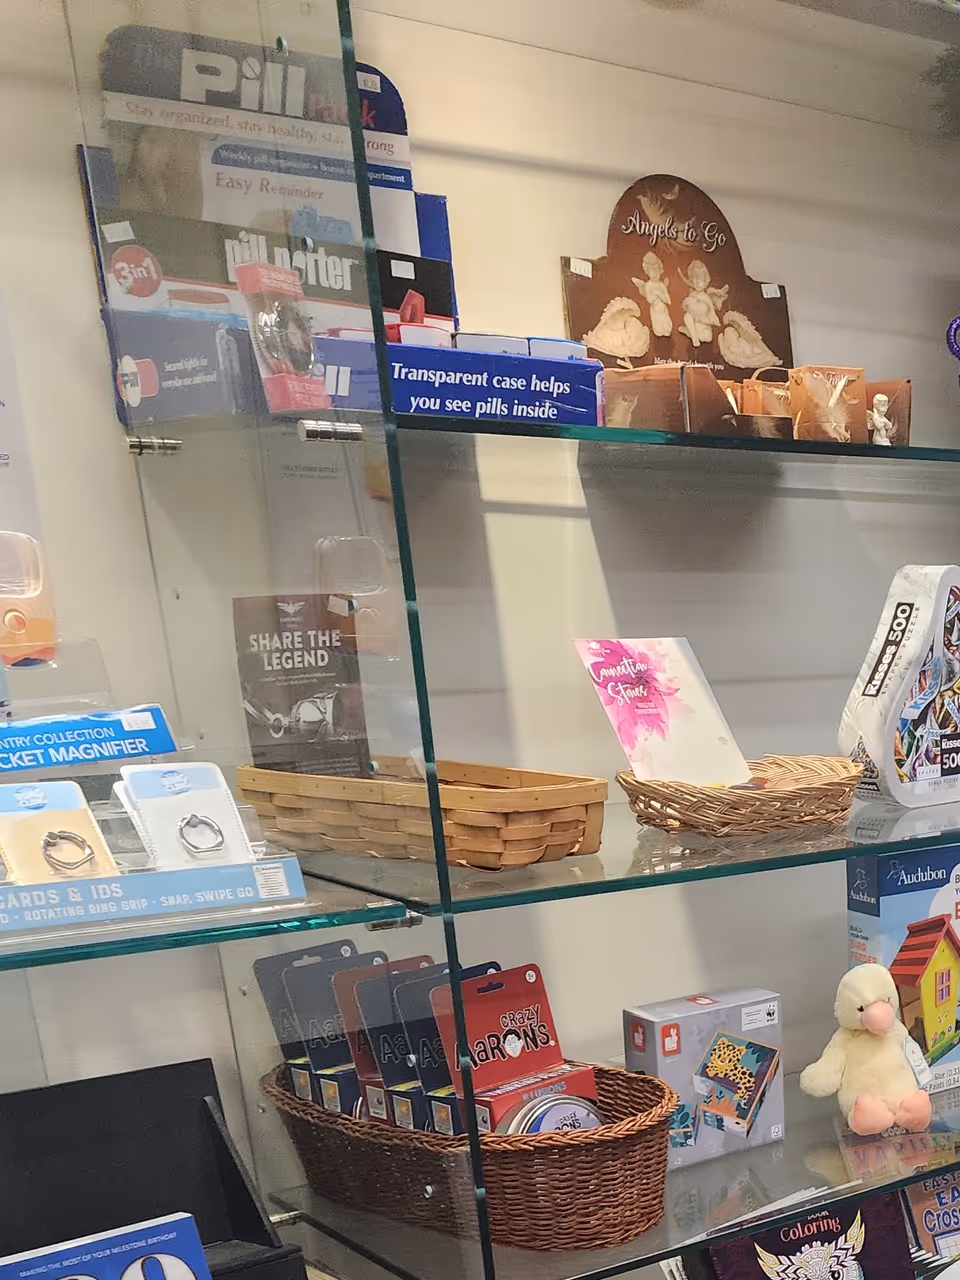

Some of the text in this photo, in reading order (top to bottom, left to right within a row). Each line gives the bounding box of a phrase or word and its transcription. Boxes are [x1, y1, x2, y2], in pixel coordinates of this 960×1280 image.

[180, 48, 306, 119] Pill
[160, 106, 233, 126] organized,
[215, 172, 324, 200] Easy Reminder
[621, 209, 727, 252] Angels to Go
[225, 231, 268, 282] pill
[391, 363, 571, 399] Transparent case helps
[410, 395, 558, 419] you see pills inside
[888, 604, 912, 642] 500
[249, 629, 342, 653] SHARE THE
[263, 650, 329, 671] LEGEND
[35, 727, 115, 746] COLLECTION
[49, 739, 150, 763] MAGNIFIER
[897, 866, 947, 886] Audubon
[24, 886, 254, 922] ROTATING RING GRIP SWIPE GO
[67, 883, 124, 902] & IDS
[849, 889, 877, 905] Audubon
[929, 1082, 945, 1091] Paints
[922, 1171, 958, 1193] FAST
[780, 1216, 842, 1244] Coloring
[62, 1256, 82, 1268] MOST
[92, 1249, 111, 1261] YOUR
[147, 1232, 177, 1246] BIRTHDAY
